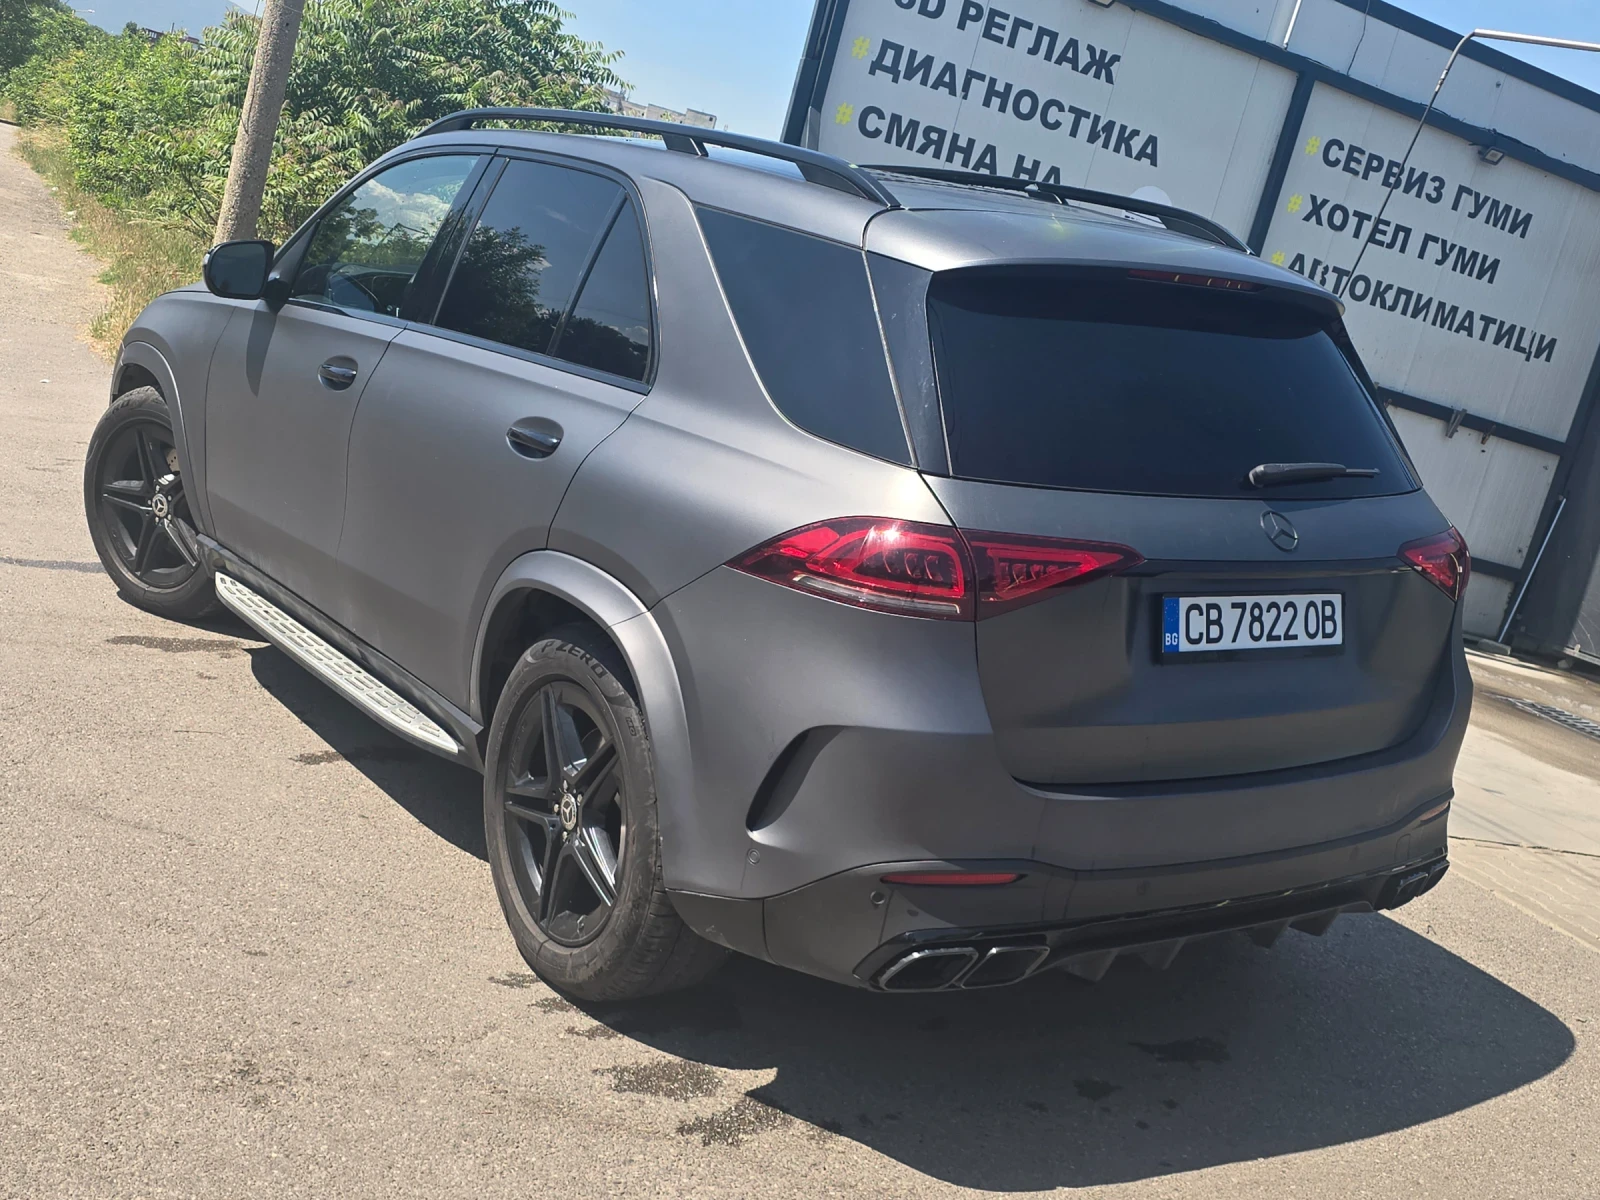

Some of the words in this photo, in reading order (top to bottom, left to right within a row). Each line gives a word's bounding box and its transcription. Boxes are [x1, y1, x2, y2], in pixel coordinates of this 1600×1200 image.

[957, 0, 1121, 85] РЕГЛАЖ
[1451, 184, 1533, 239] ГУМИ
[1417, 233, 1500, 285] ГУМИ
[556, 643, 608, 678] ZERO
[1165, 633, 1178, 646] BG
